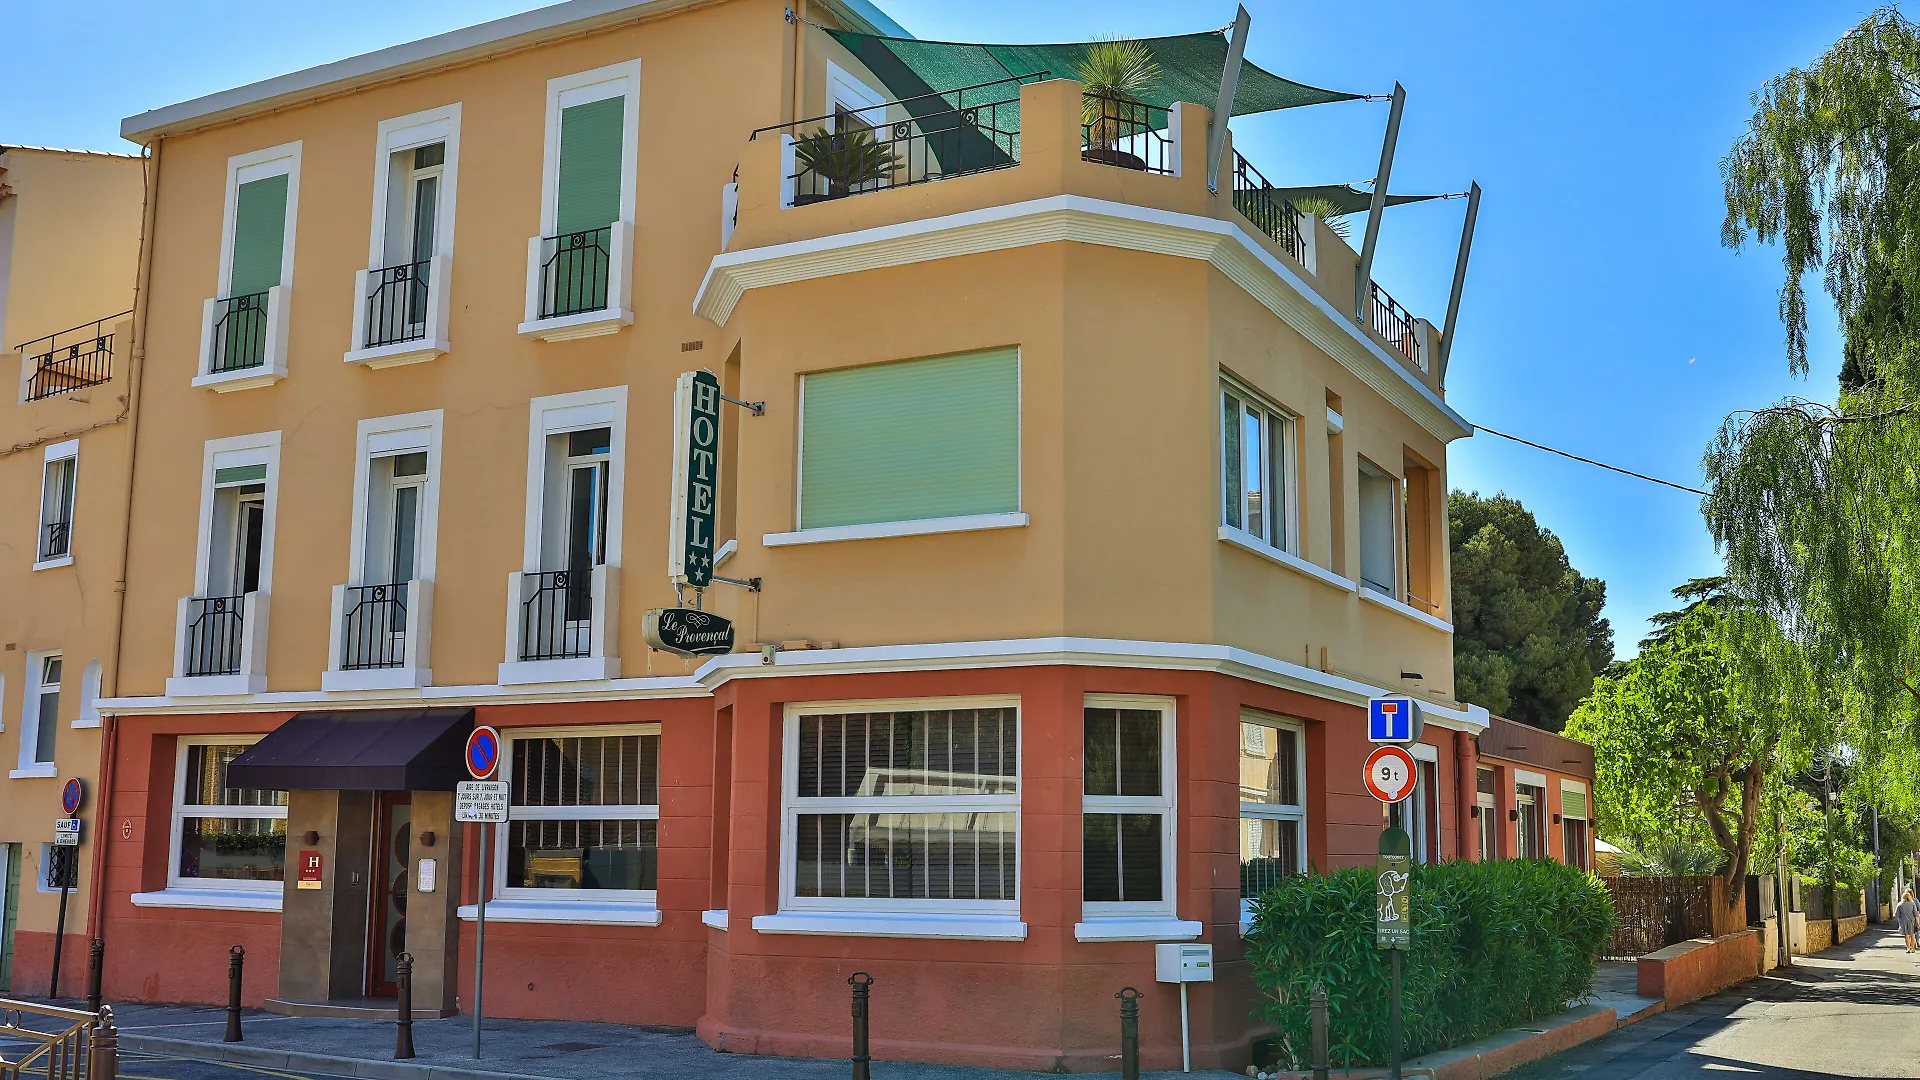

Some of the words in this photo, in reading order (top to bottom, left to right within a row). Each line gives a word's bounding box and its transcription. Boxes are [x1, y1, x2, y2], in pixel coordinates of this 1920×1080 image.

[690, 380, 718, 549] HOTEL
[661, 612, 678, 631] Le
[675, 622, 732, 646] Provençal
[1381, 767, 1391, 781] 9
[1393, 771, 1399, 781] t
[308, 856, 320, 868] H
